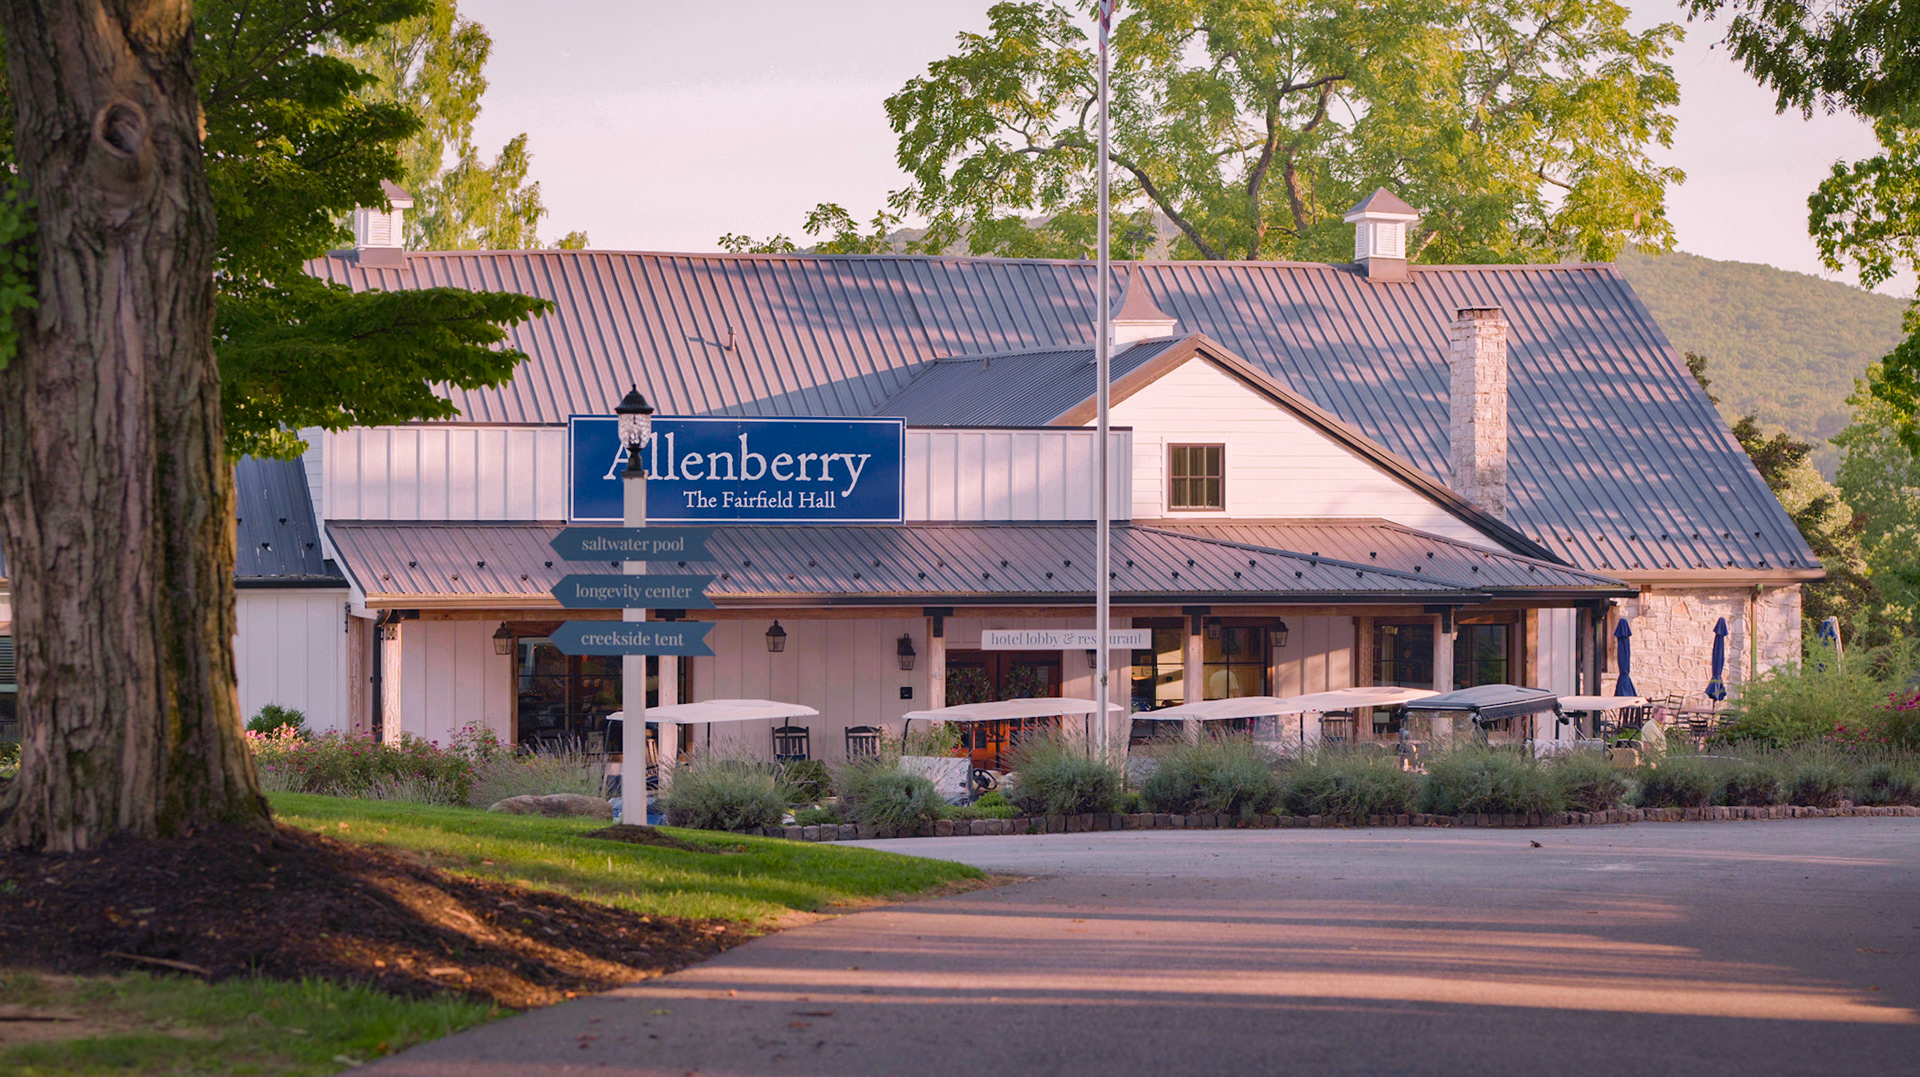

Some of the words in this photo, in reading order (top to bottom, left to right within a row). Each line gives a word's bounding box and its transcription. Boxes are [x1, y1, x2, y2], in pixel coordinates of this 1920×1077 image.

[683, 490, 717, 508] The
[721, 490, 793, 509] Fairfield
[798, 490, 836, 509] Hall
[581, 536, 649, 551] saltwater
[653, 537, 684, 554] pool
[575, 583, 641, 601] longevity
[644, 585, 692, 599] center
[581, 631, 651, 646] creekside
[654, 633, 685, 646] tent
[991, 632, 1023, 646] hotel
[1026, 632, 1059, 647] lobby
[1063, 633, 1075, 645] &
[1078, 634, 1142, 645] resurant
